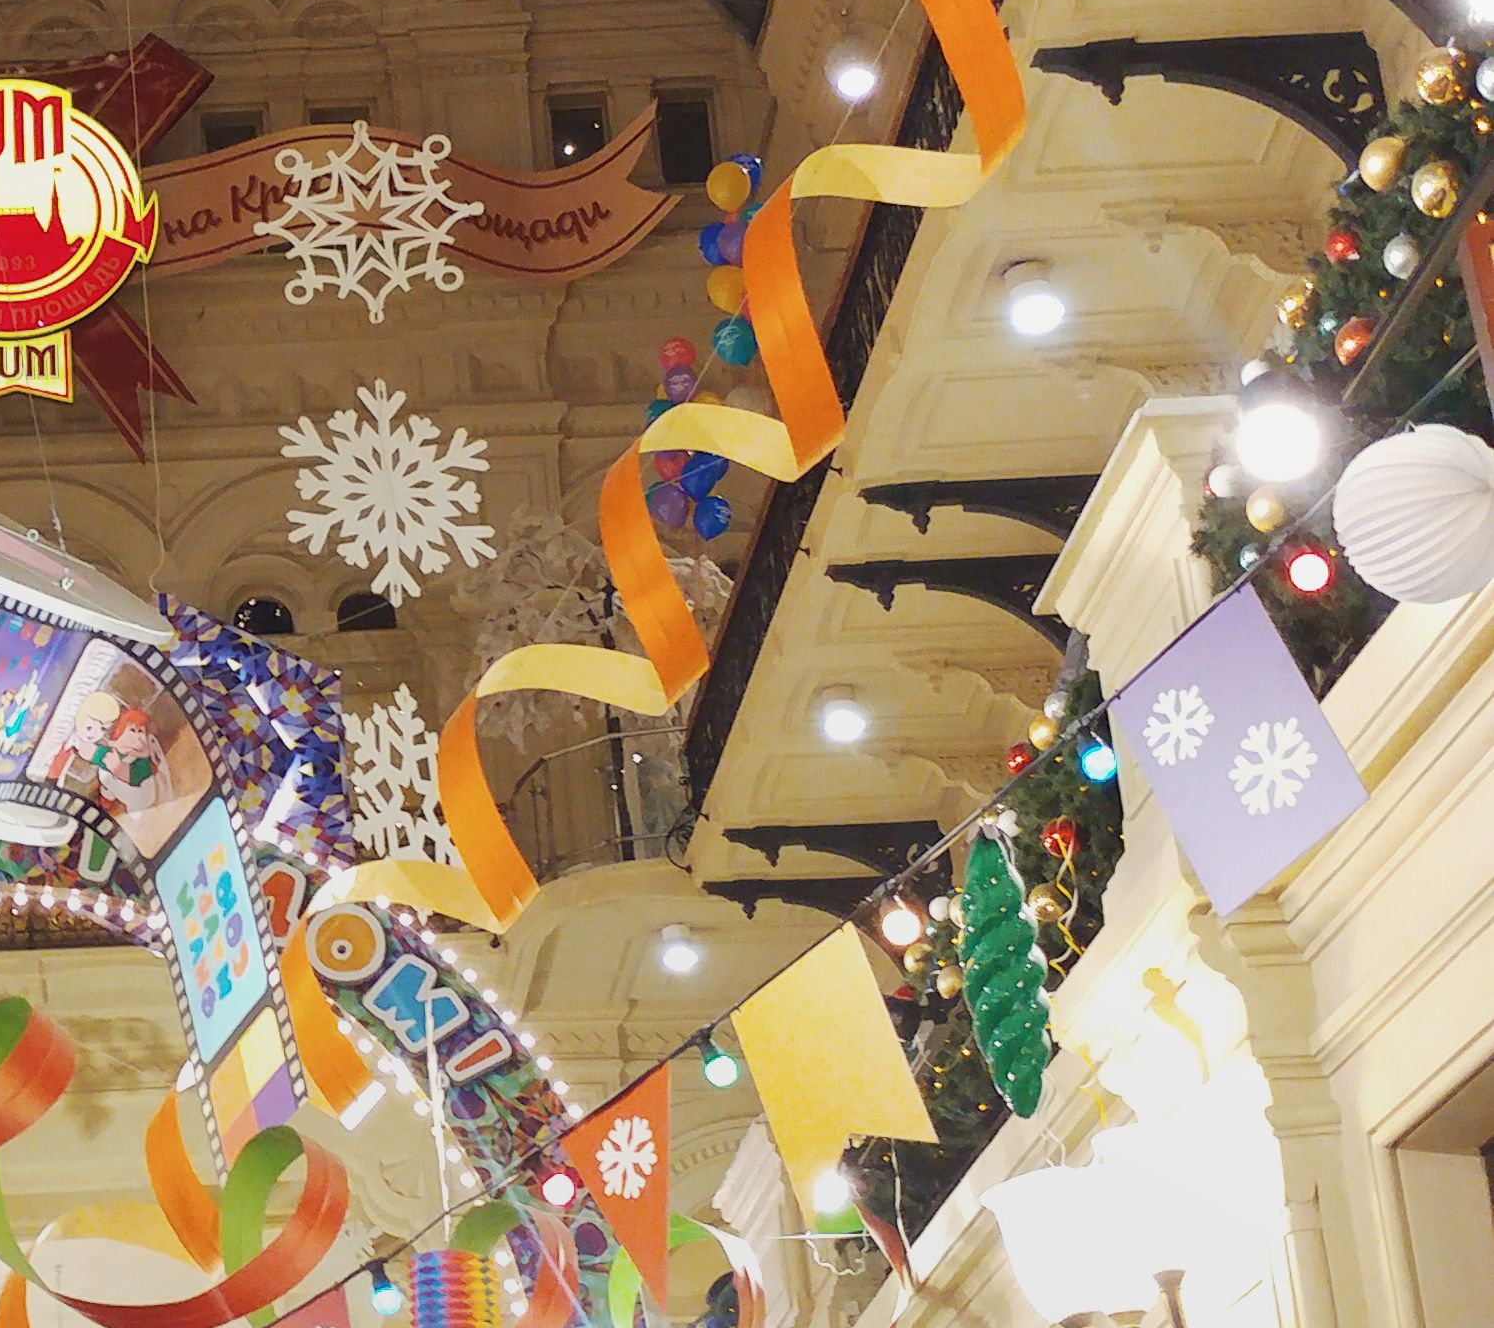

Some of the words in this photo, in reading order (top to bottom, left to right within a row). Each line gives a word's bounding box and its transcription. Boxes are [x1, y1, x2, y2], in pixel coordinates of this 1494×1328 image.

[163, 211, 222, 246] на
[464, 200, 611, 252] ощади
[9, 257, 122, 326] ПЛОЩАДЬ
